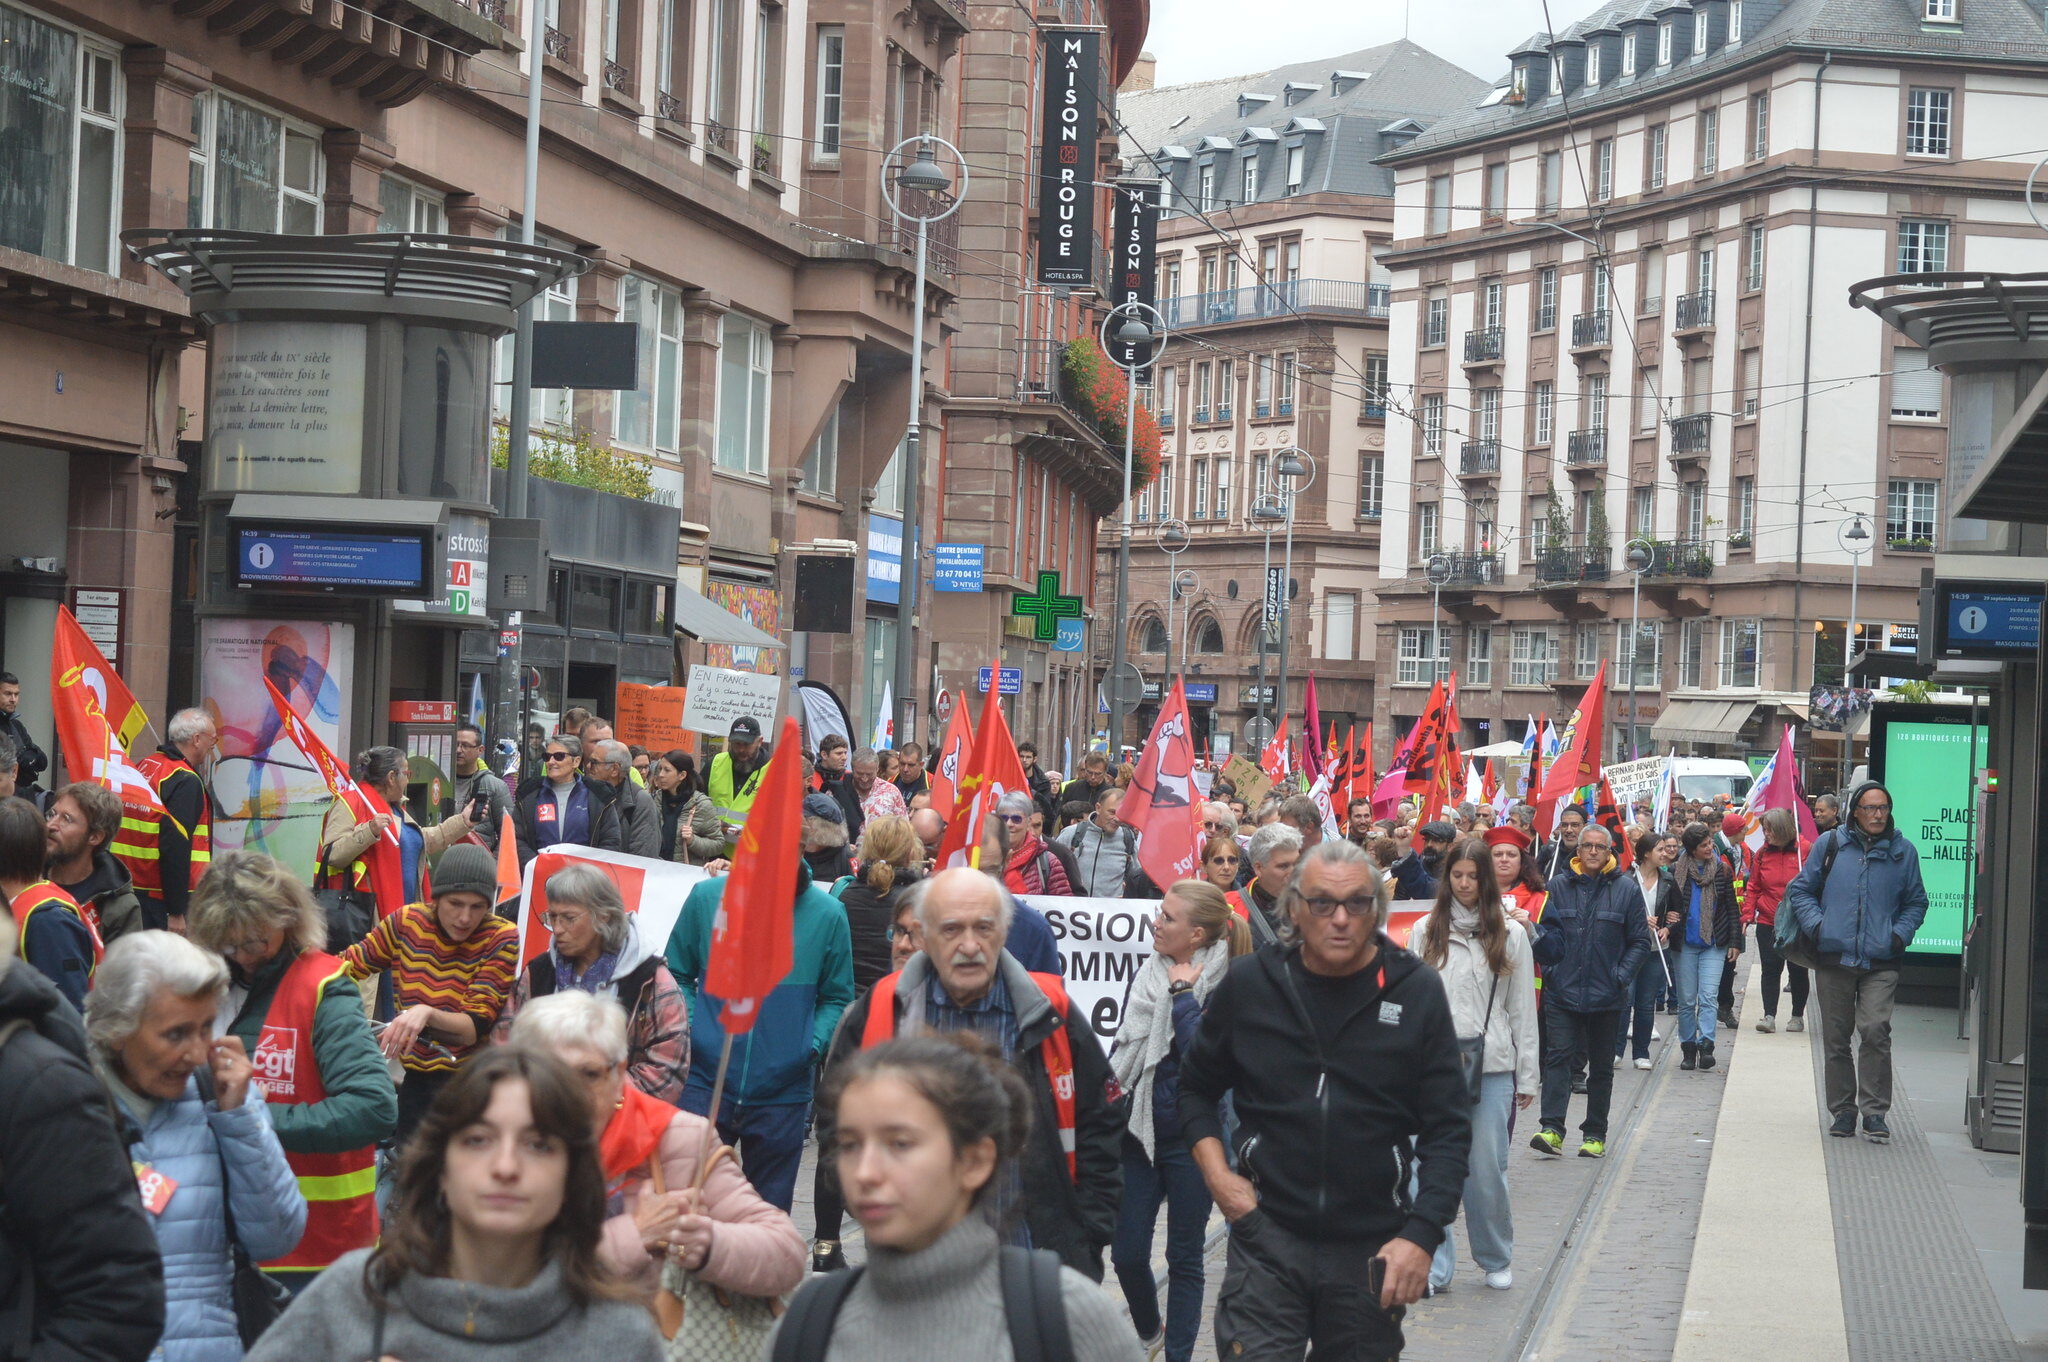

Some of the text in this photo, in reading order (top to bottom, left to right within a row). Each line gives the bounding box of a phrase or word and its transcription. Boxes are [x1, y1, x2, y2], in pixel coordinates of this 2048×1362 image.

[1058, 38, 1082, 257] MAISON ROUGE
[1127, 190, 1144, 270] MAISON
[1045, 272, 1066, 280] HOTEL
[1071, 273, 1083, 281] SPA
[270, 351, 282, 362] du
[304, 352, 331, 363] siècle
[254, 368, 293, 382] première
[295, 368, 316, 382] fois
[321, 369, 330, 380] le
[242, 386, 255, 396] Les
[258, 385, 302, 396] caractères
[307, 388, 330, 397] sont
[250, 402, 260, 413] La
[263, 402, 297, 413] dernière
[301, 402, 328, 416] lettre,
[248, 420, 284, 430] demeure
[290, 420, 299, 430] la
[305, 420, 328, 433] plus
[956, 547, 982, 555] DENTAIRE
[936, 558, 981, 566] OPHTALMOLOGIQUE
[456, 564, 467, 584] A
[954, 570, 963, 578] 70
[963, 570, 972, 578] 04
[973, 570, 981, 578] 15
[455, 592, 466, 612] D
[716, 673, 749, 686] FRANCE
[1911, 734, 1950, 742] BOUTIQUES
[1607, 764, 1635, 777] BERNARD
[1620, 774, 1632, 784] QUE
[1634, 772, 1644, 780] TU
[1626, 783, 1637, 792] JET
[1638, 780, 1647, 789] ET
[1921, 825, 1943, 841] DES
[253, 1048, 294, 1078] cgt
